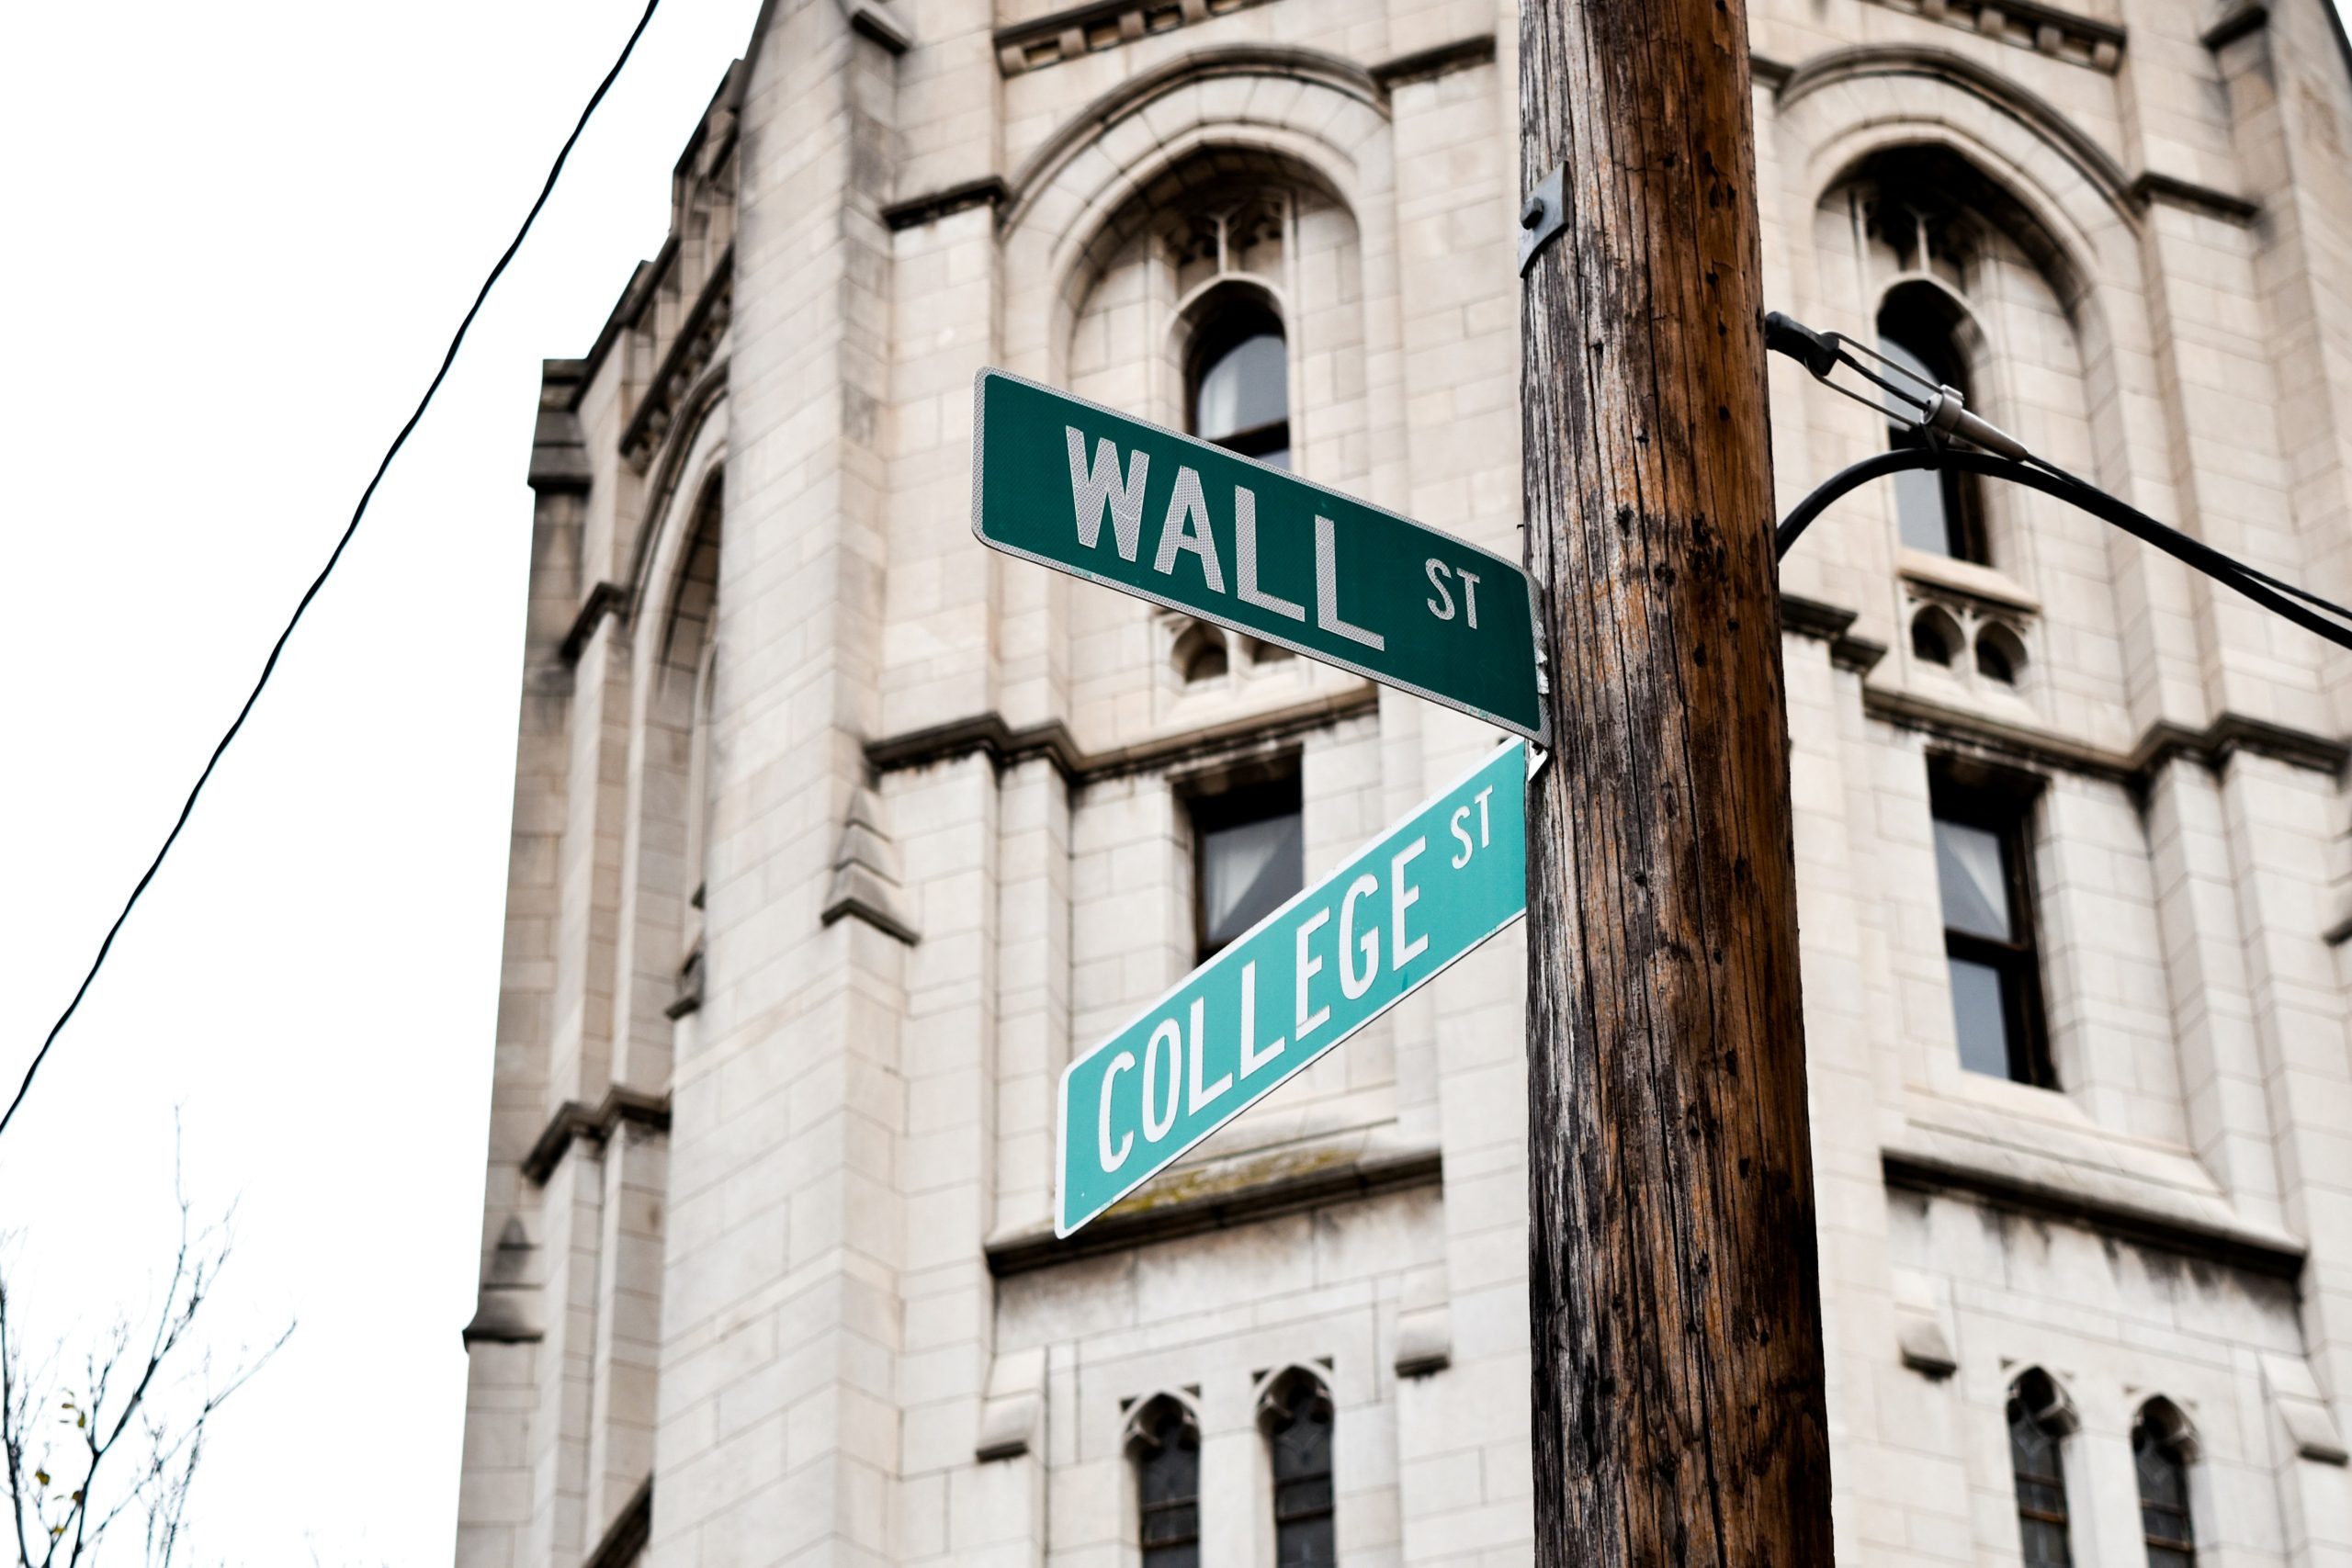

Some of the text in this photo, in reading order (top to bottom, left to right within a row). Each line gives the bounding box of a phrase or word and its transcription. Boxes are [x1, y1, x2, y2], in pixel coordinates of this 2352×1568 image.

[1066, 425, 1480, 651] WALL ST
[1099, 784, 1493, 1173] COLLEGE ST
